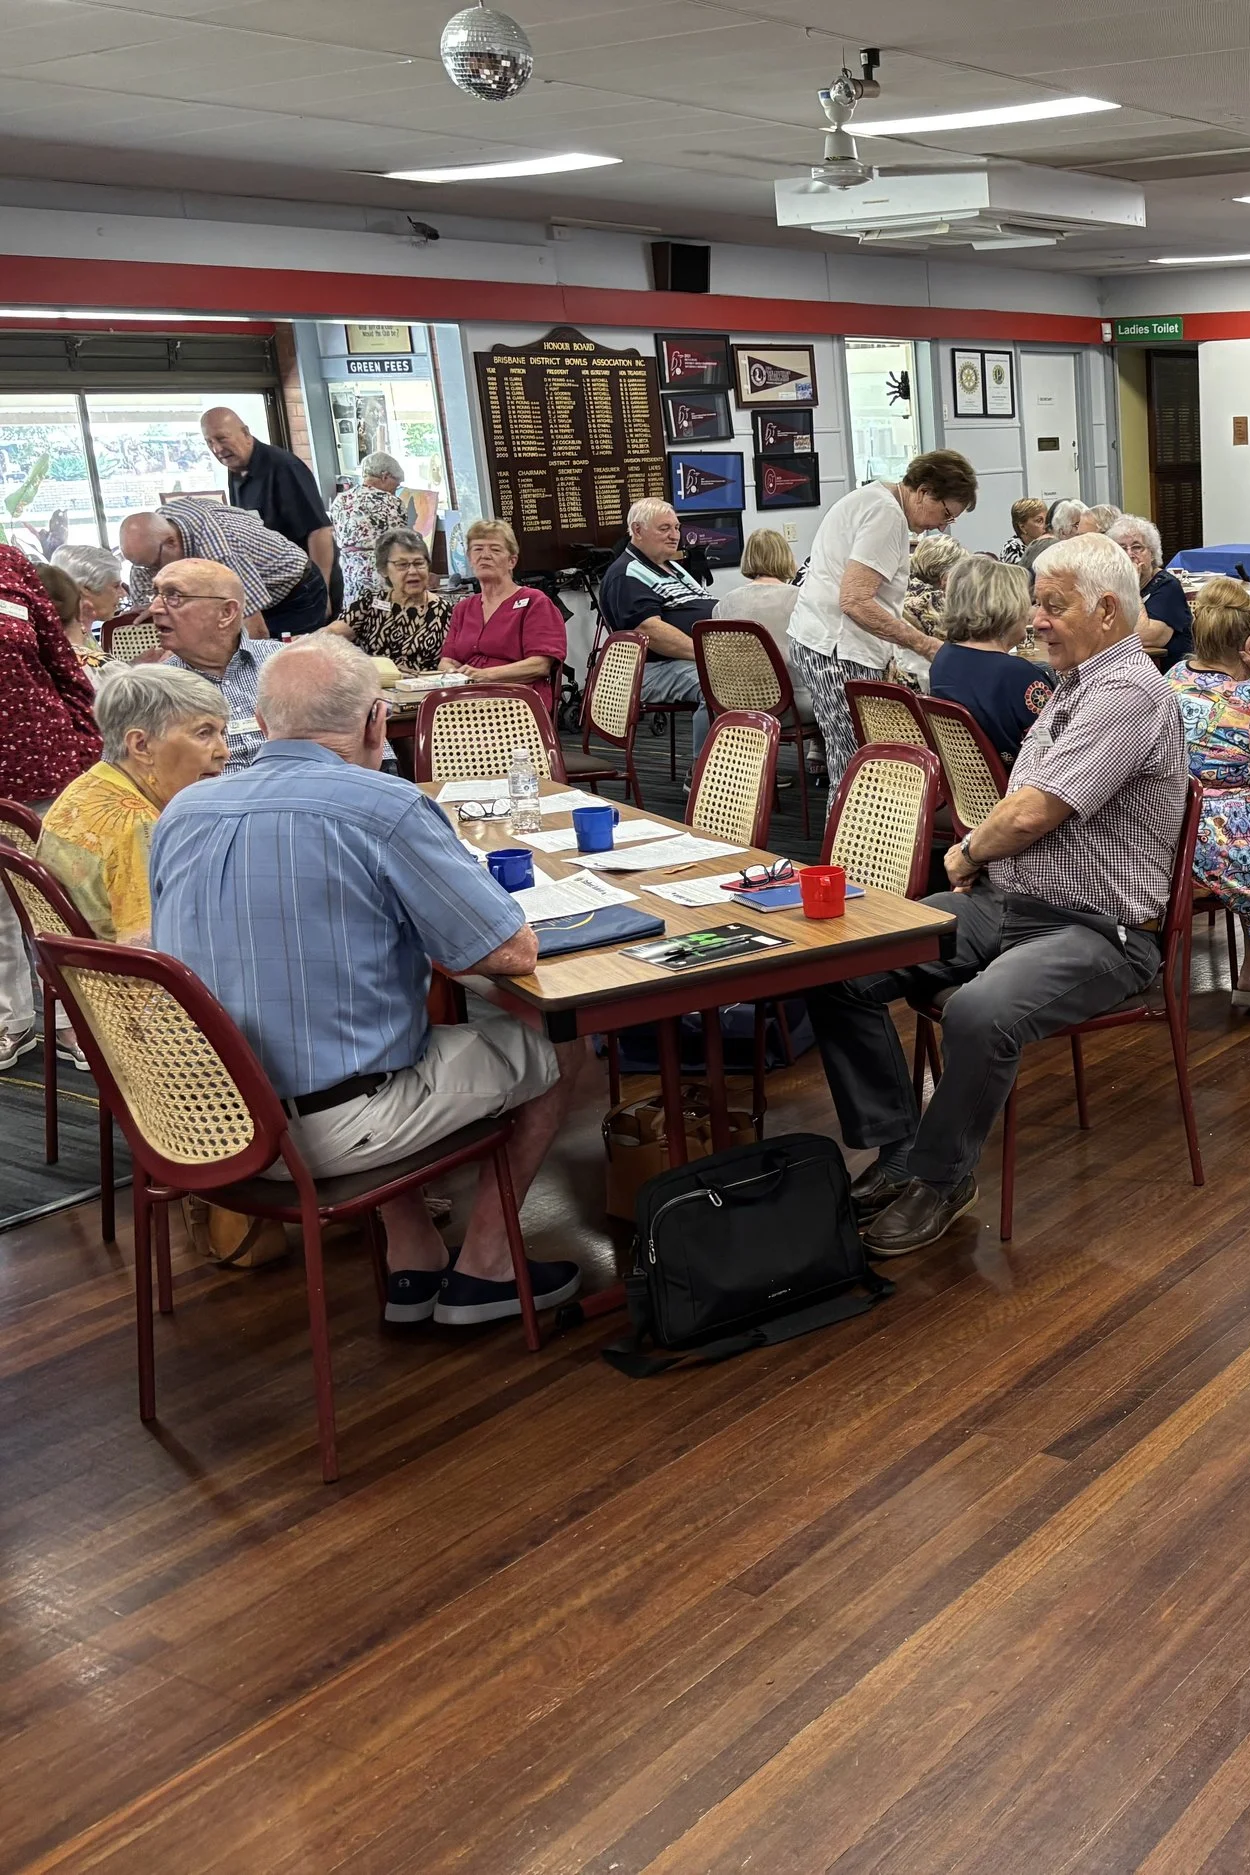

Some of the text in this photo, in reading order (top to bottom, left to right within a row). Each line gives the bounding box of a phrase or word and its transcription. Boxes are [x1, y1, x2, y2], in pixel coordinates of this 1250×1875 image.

[1118, 323, 1179, 335] Ladies Toilet
[544, 342, 595, 351] HONOUR BOARD
[350, 360, 409, 372] GREEN FEES
[493, 356, 526, 364] BRISBANE
[529, 357, 561, 365] DISTRICT
[565, 358, 588, 366] BOWLS
[592, 358, 632, 366] ASSOCIATION
